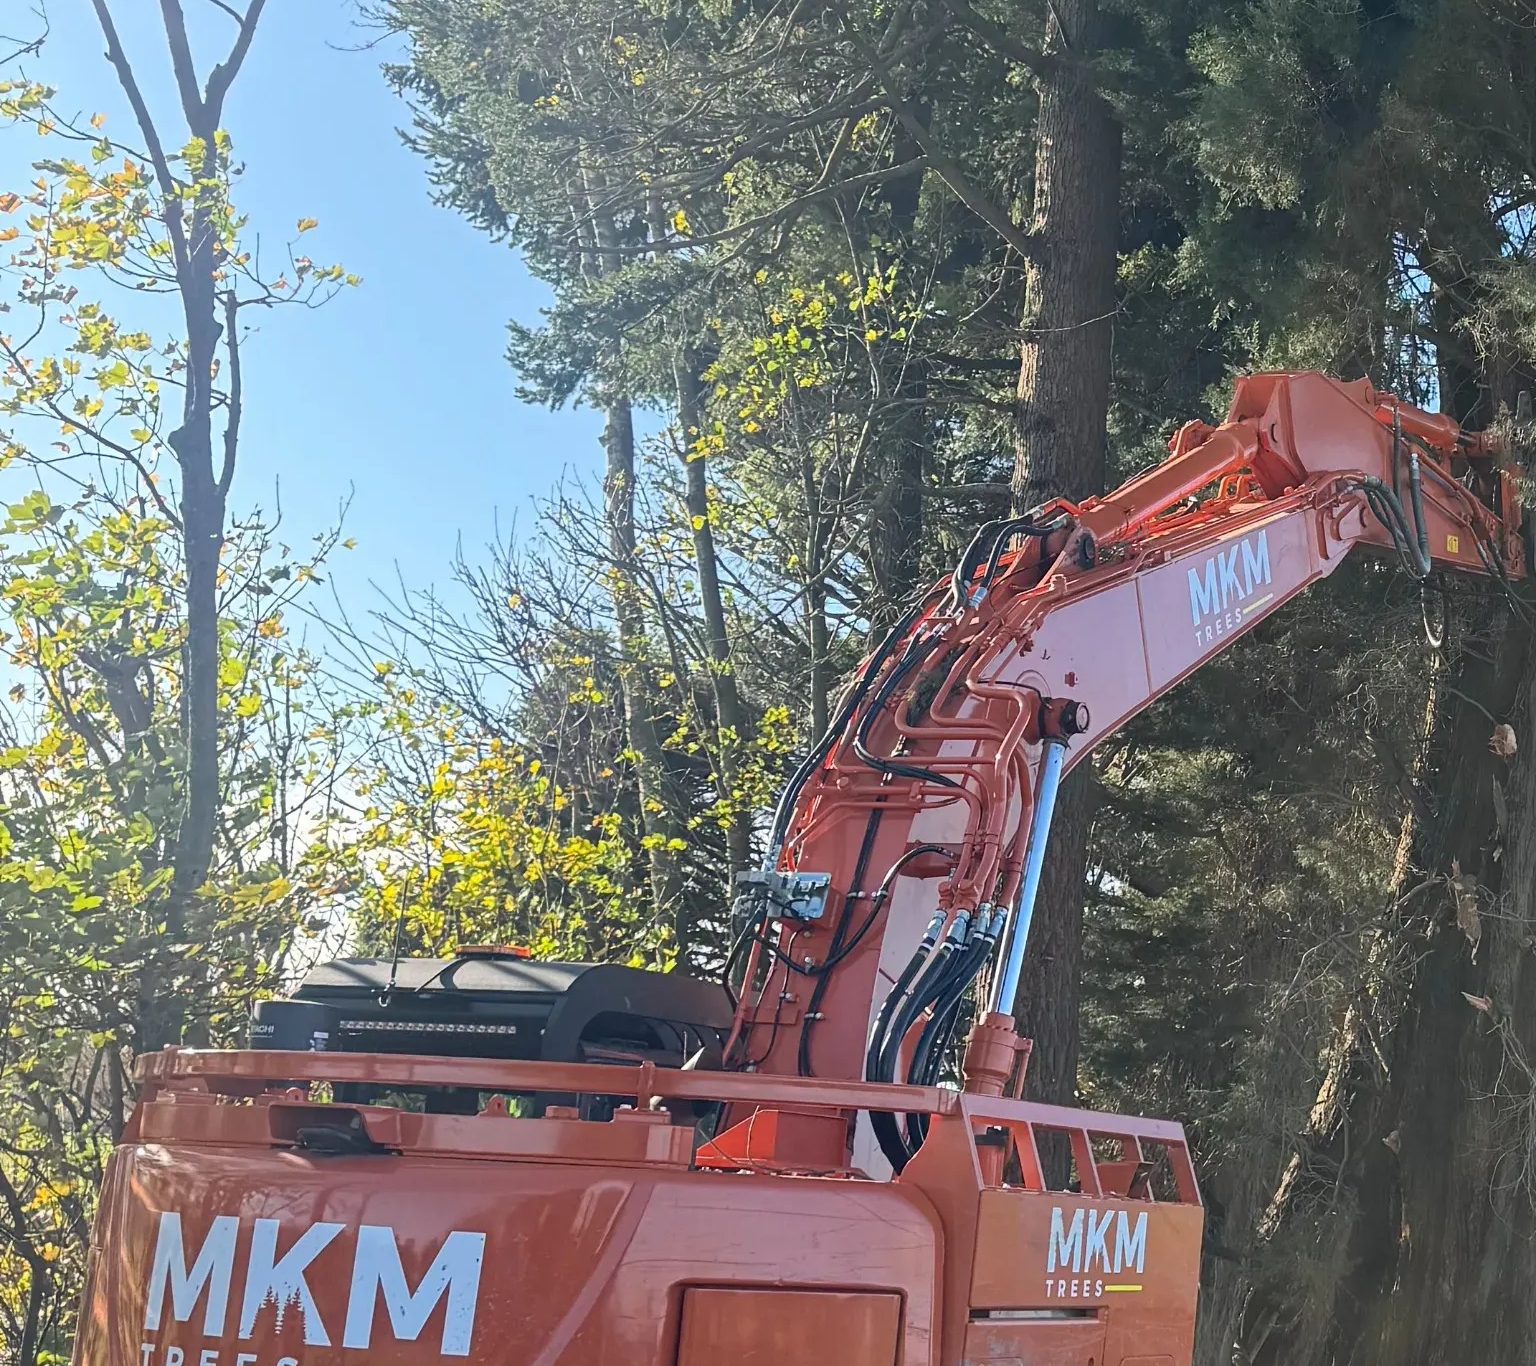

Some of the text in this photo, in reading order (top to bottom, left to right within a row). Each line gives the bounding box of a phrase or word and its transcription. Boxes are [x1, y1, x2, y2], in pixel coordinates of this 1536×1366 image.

[1187, 529, 1272, 627] MKM
[1195, 608, 1242, 647] TREES
[1046, 1206, 1148, 1274] MKM
[143, 1211, 487, 1357] MKM
[1045, 1279, 1103, 1298] TREES
